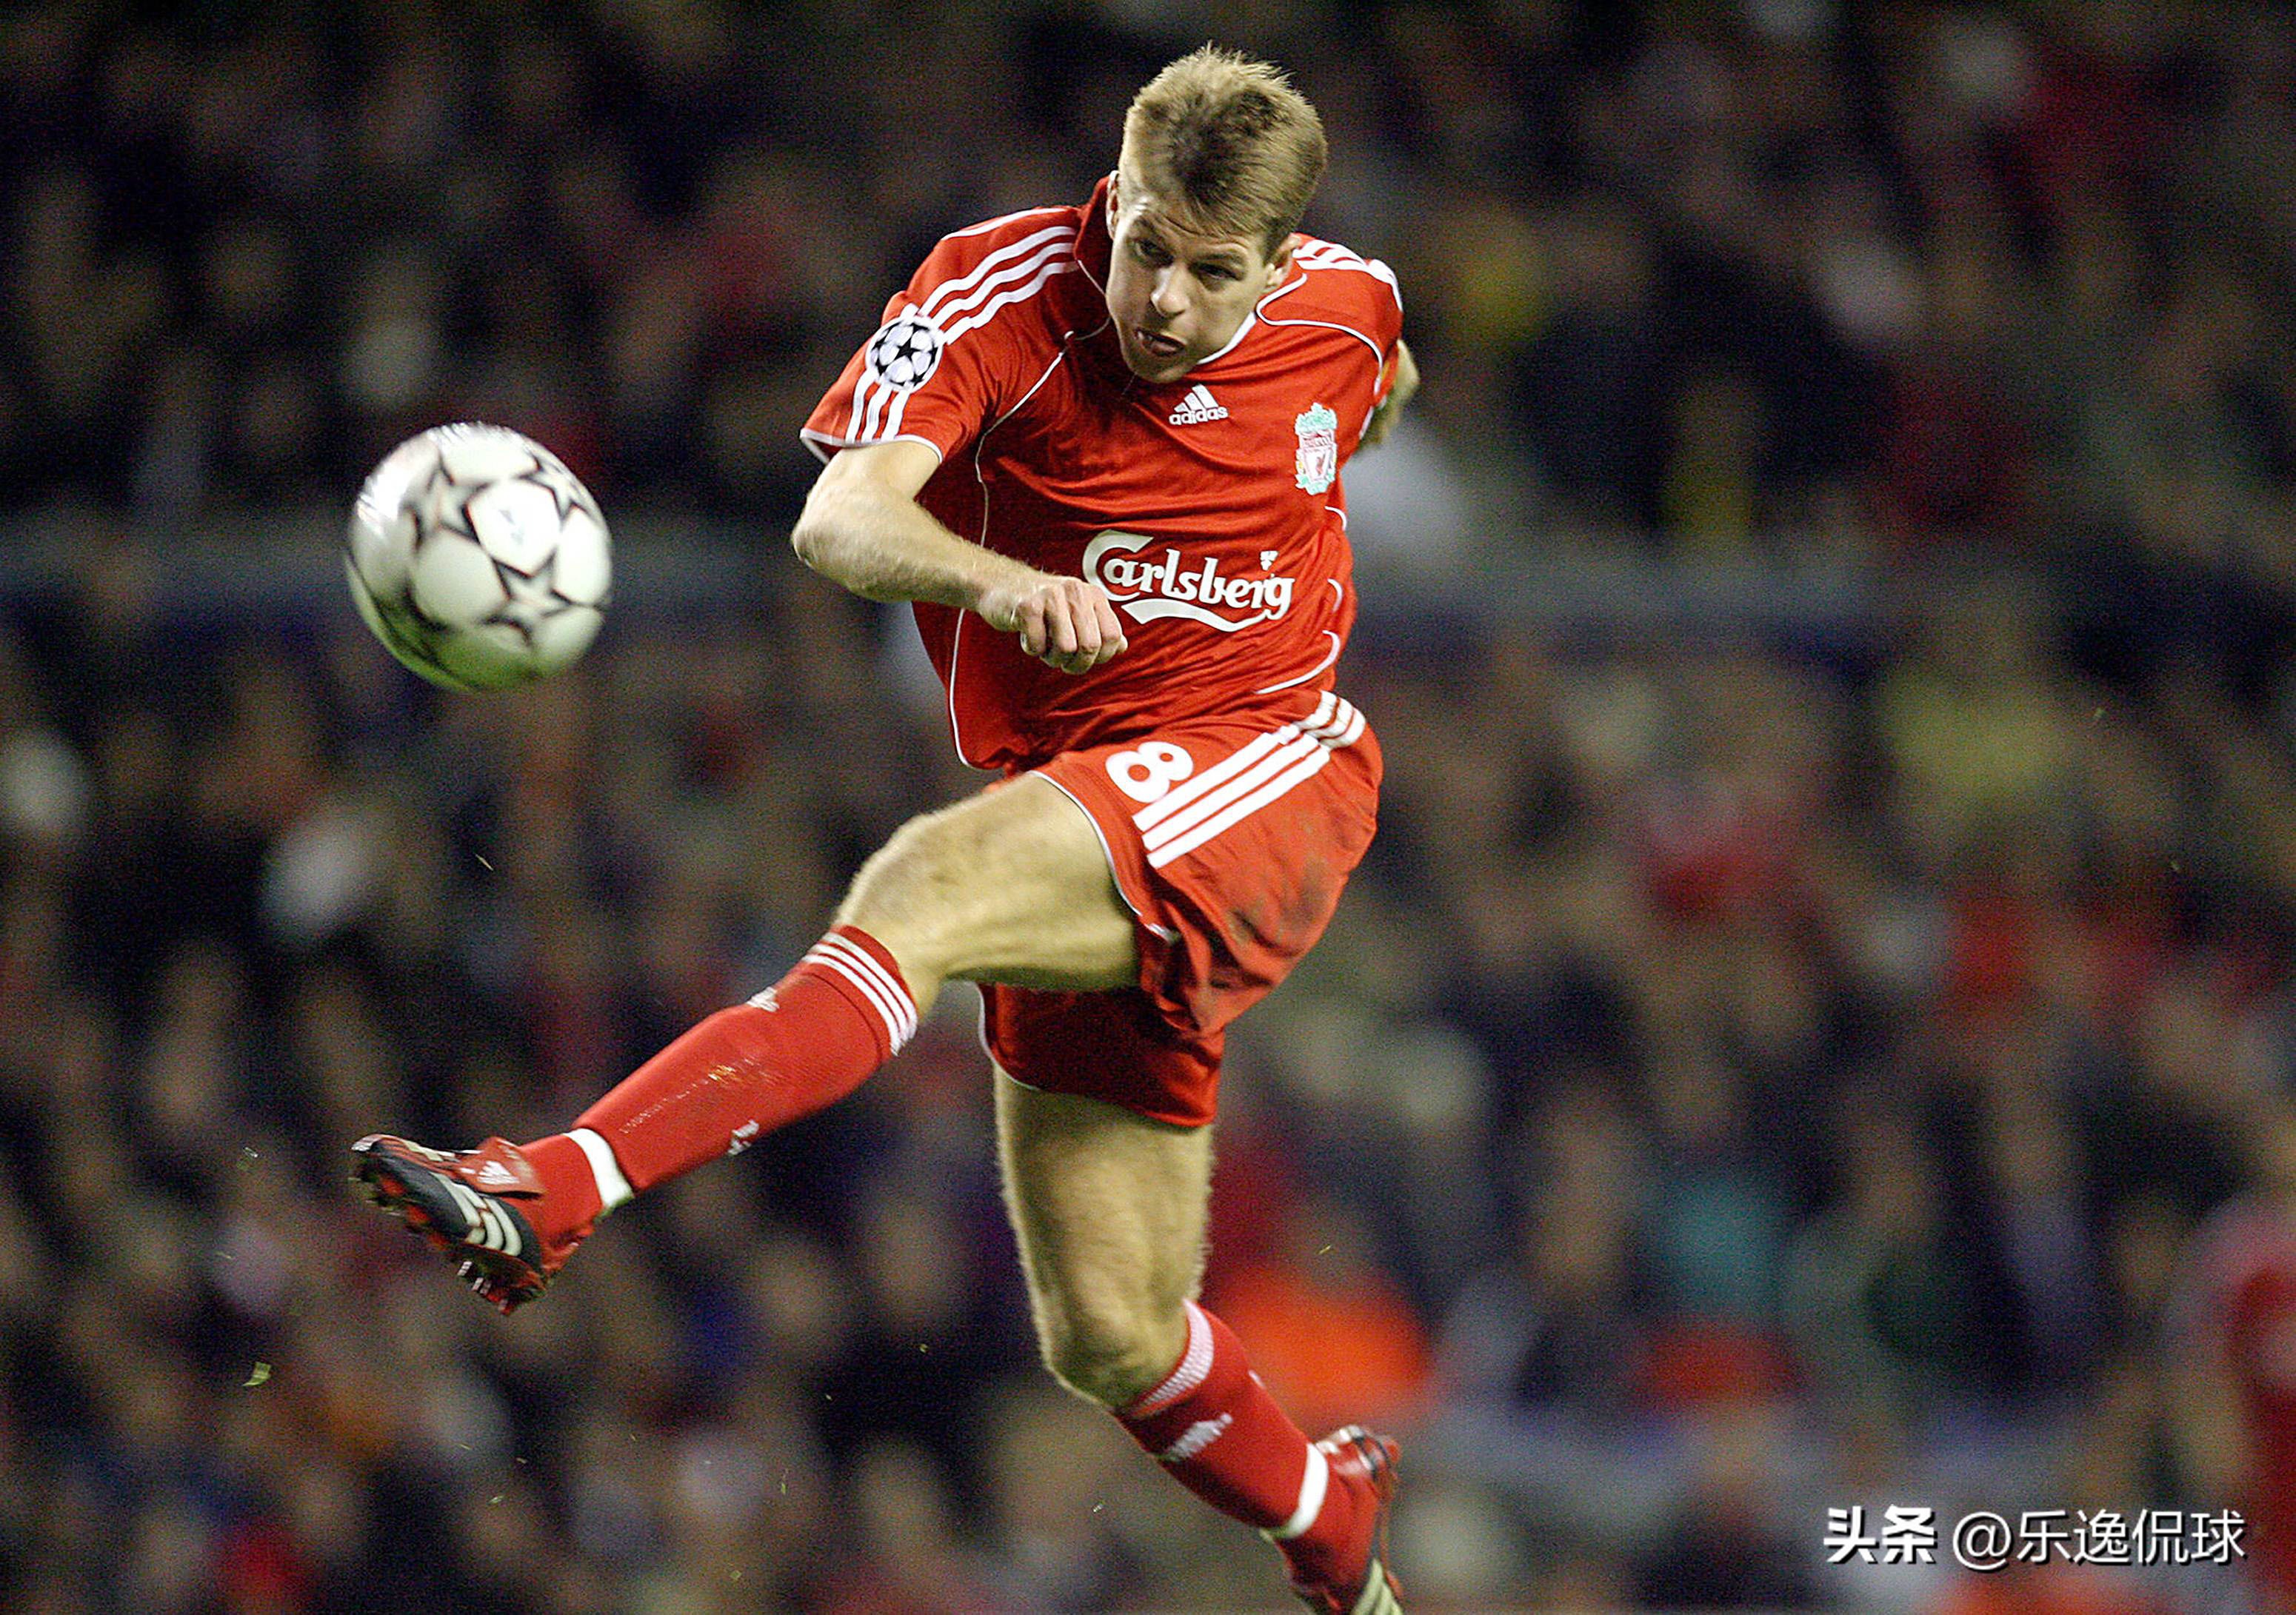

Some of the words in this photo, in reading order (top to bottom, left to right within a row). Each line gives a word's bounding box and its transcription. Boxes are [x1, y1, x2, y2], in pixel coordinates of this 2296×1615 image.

[1169, 406, 1229, 425] adidas
[1082, 529, 1295, 621] Carlsberg
[1105, 740, 1194, 803] 8
